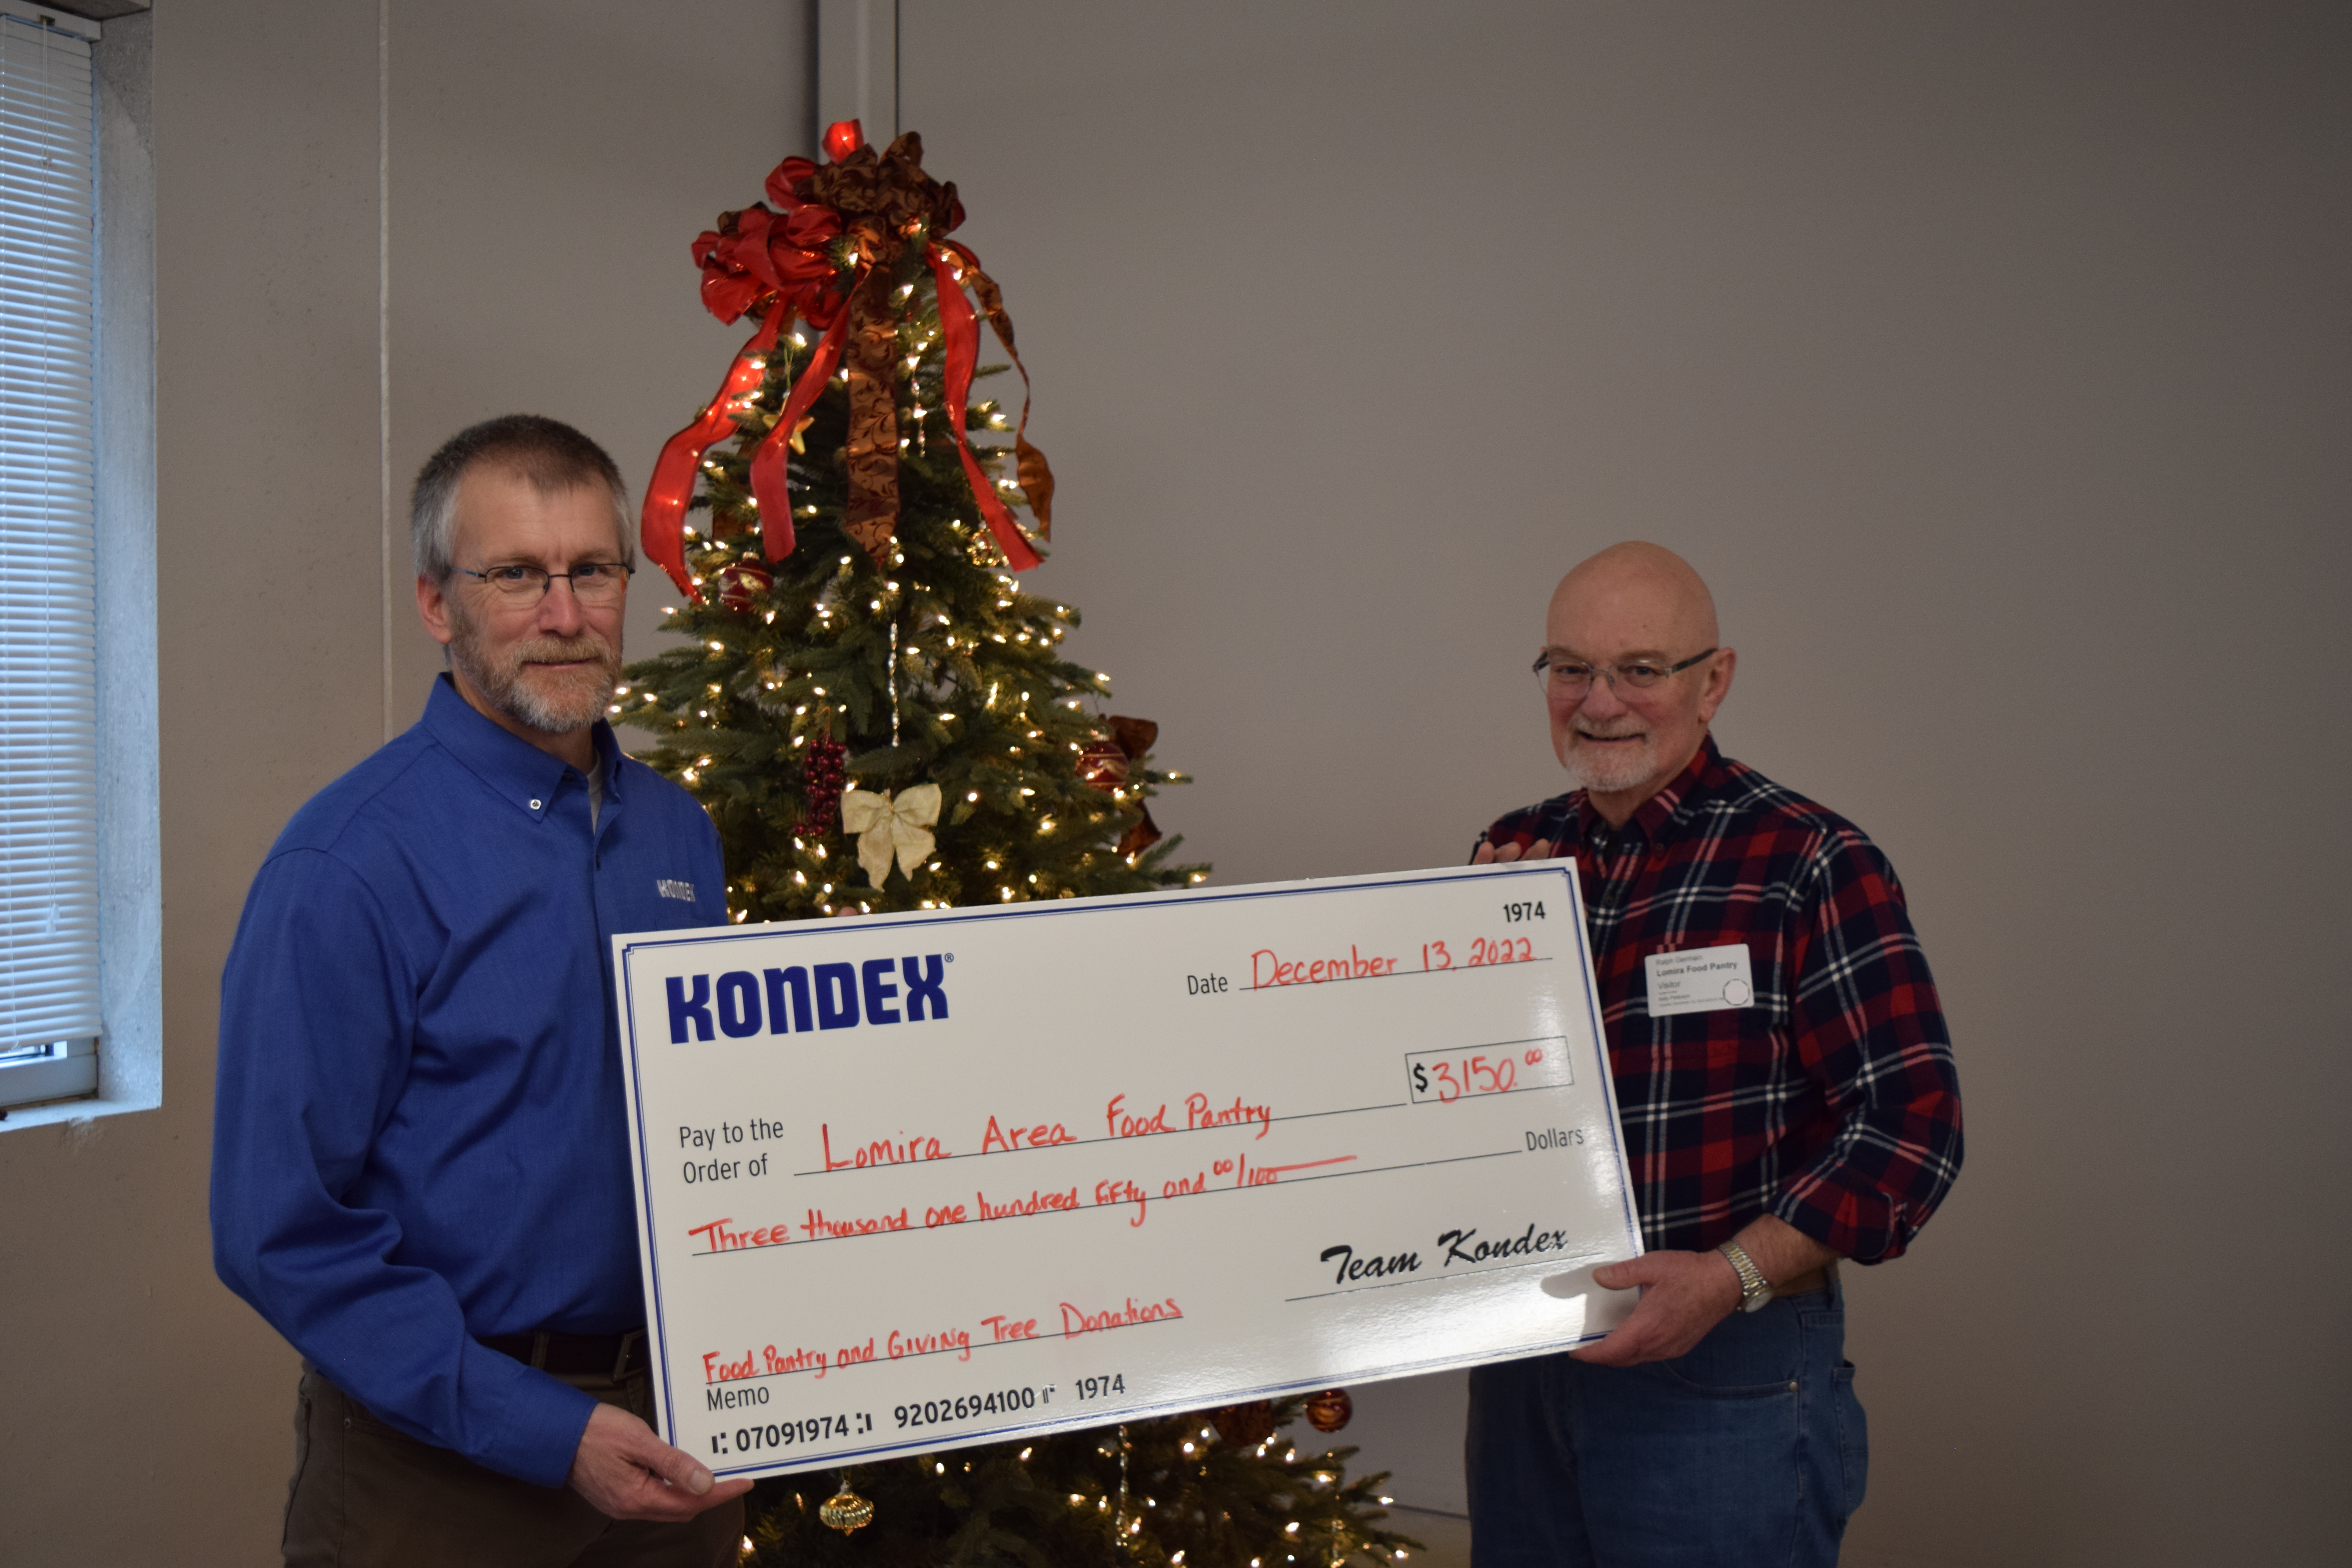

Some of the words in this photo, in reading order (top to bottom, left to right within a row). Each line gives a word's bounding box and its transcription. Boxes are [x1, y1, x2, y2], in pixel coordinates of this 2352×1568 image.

[1503, 901, 1546, 922] 1974
[1251, 944, 1397, 990] December
[1468, 937, 1536, 966] 2022
[1686, 964, 1708, 973] Food
[1710, 962, 1738, 970] Pantry
[1187, 973, 1228, 995] Date
[679, 1125, 715, 1151] Pay
[723, 1122, 744, 1144] to
[750, 1118, 784, 1142] the
[822, 1123, 952, 1172] Lomira
[982, 1115, 1076, 1154] Area
[1106, 1093, 1176, 1137] Food
[1184, 1092, 1270, 1140] Pantry
[1525, 1127, 1584, 1151] Dollars
[683, 1158, 741, 1184] Order
[748, 1152, 768, 1176] of
[688, 1218, 790, 1253] Three
[800, 1207, 916, 1240] thousand
[926, 1204, 967, 1229] one
[976, 1191, 1080, 1221] hundred
[1163, 1171, 1207, 1199] and
[1320, 1244, 1422, 1285] Team
[1437, 1223, 1568, 1267] Kondex
[702, 1350, 760, 1387] Food
[763, 1344, 827, 1379] Pantry
[837, 1337, 878, 1369] and
[981, 1315, 1040, 1343] Tree
[1060, 1298, 1183, 1340] Donations
[706, 1386, 769, 1411] Memo
[736, 1414, 849, 1452] 07091974
[894, 1387, 1035, 1428] 9202694100
[1076, 1373, 1126, 1401] 1974
